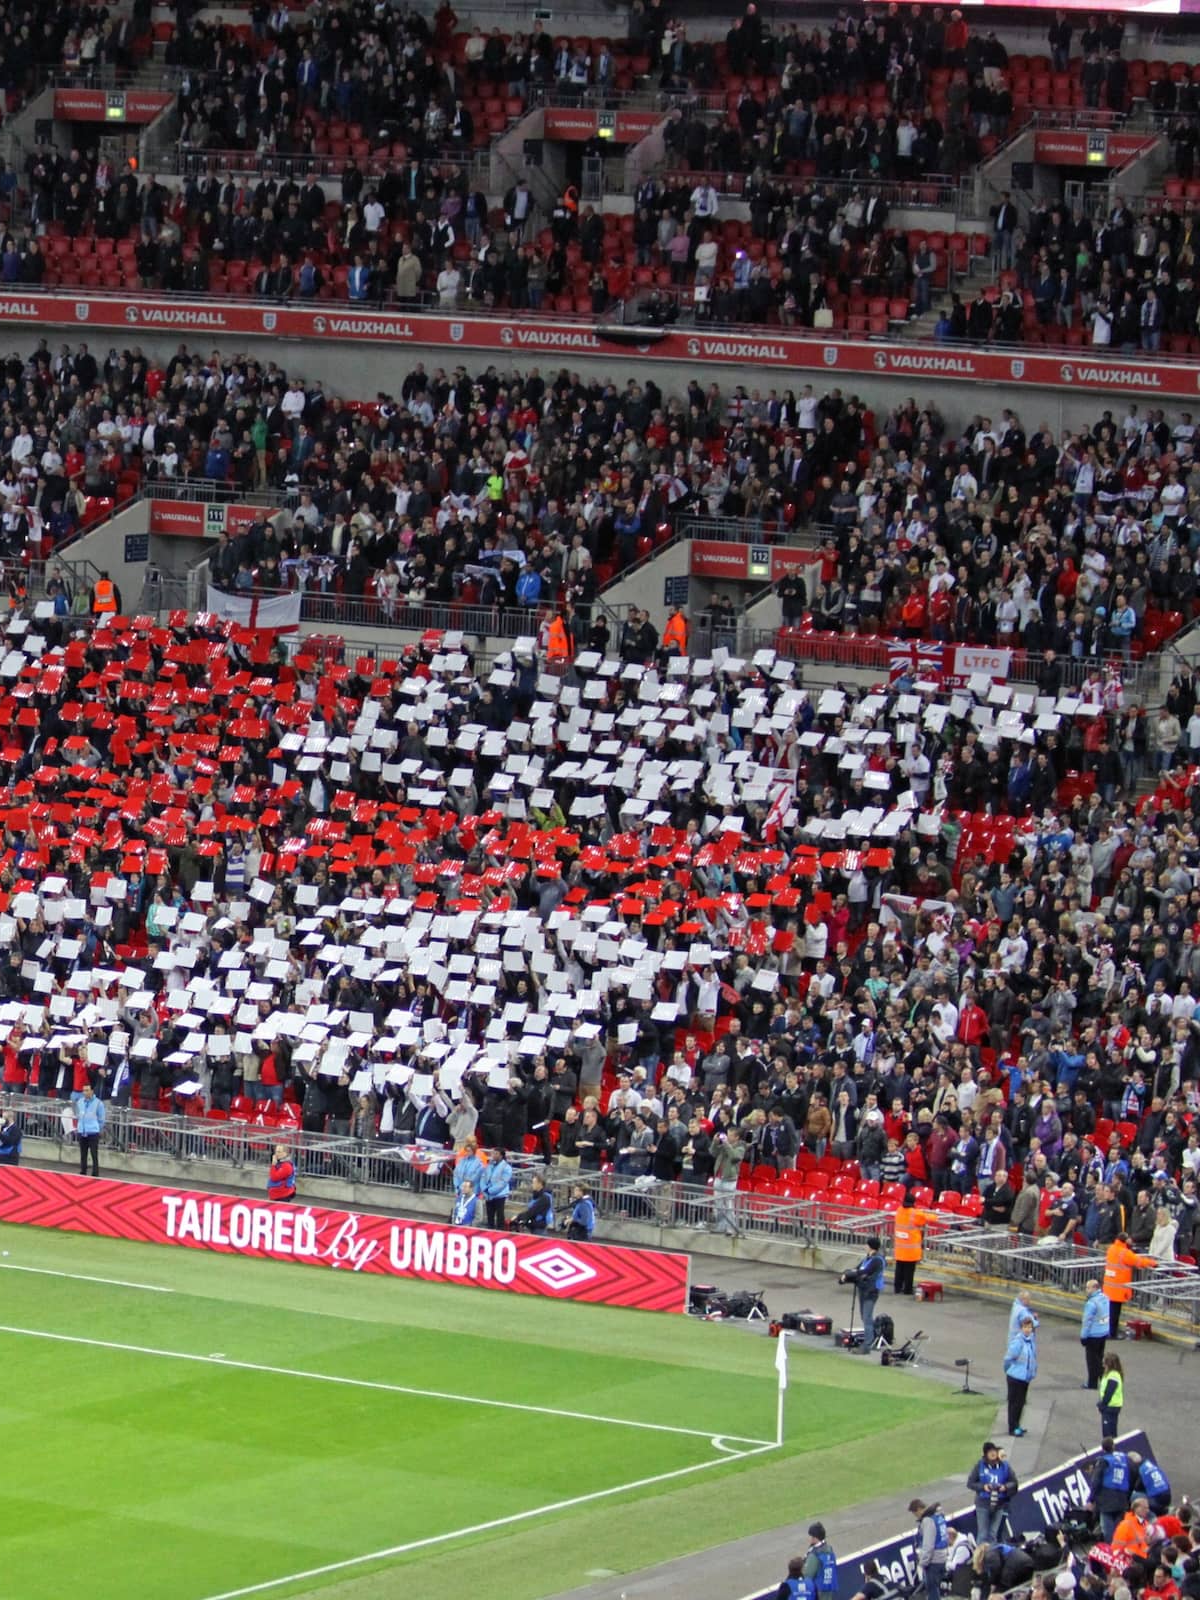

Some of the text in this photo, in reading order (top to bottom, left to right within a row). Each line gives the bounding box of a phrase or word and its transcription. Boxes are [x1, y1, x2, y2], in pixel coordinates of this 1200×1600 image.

[108, 96, 123, 105] 212
[141, 309, 225, 325] VAUXHALL
[329, 318, 413, 334] VAUXHALL
[517, 329, 600, 347] VAUXHALL
[703, 341, 787, 360] VAUXHALL
[890, 354, 975, 373] VAUXHALL
[1077, 366, 1161, 386] VAUXHALL
[160, 512, 201, 524] VAUXHALL
[209, 510, 223, 521] 111
[702, 553, 744, 565] VAUXHALL
[752, 551, 767, 562] 112
[963, 655, 1000, 668] LTFC
[162, 1196, 517, 1283] TAILORED By UMBRO
[1032, 1469, 1091, 1526] The FA
[860, 1558, 906, 1587] he
